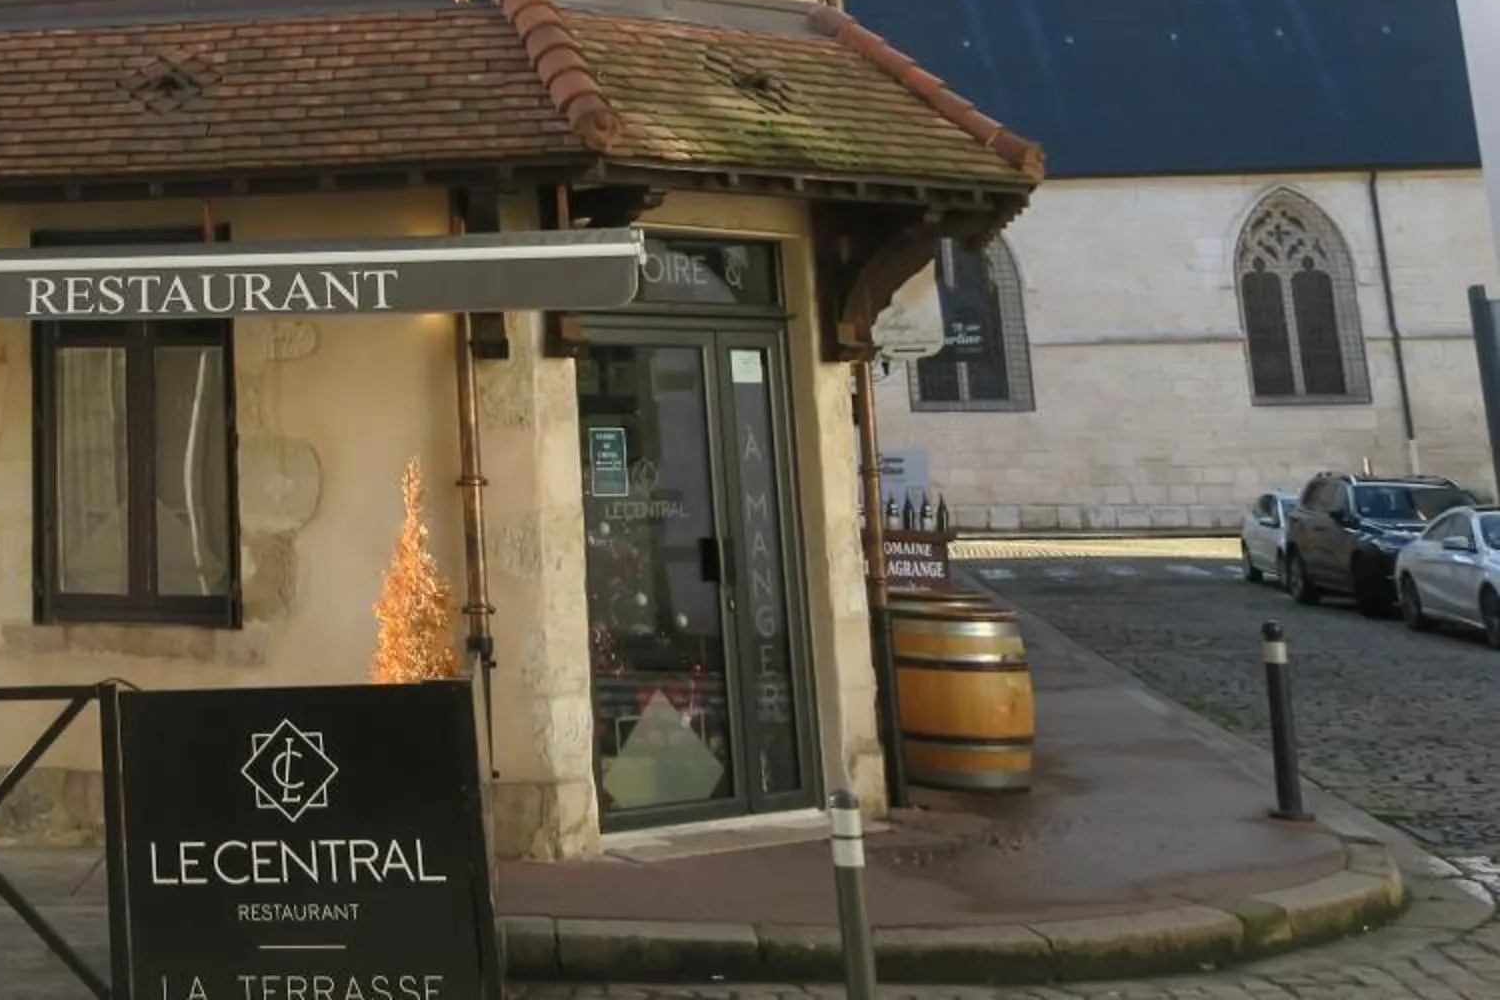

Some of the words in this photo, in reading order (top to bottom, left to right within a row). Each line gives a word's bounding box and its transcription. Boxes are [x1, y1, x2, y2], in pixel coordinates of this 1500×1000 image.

[642, 252, 708, 285] OIRE
[25, 269, 399, 317] RESTAURANT
[883, 541, 933, 557] OMAINE
[886, 560, 945, 578] AGRANGE
[238, 903, 360, 922] RESTAURANT
[162, 975, 208, 1000] LA
[237, 975, 444, 1000] TERRASSE
